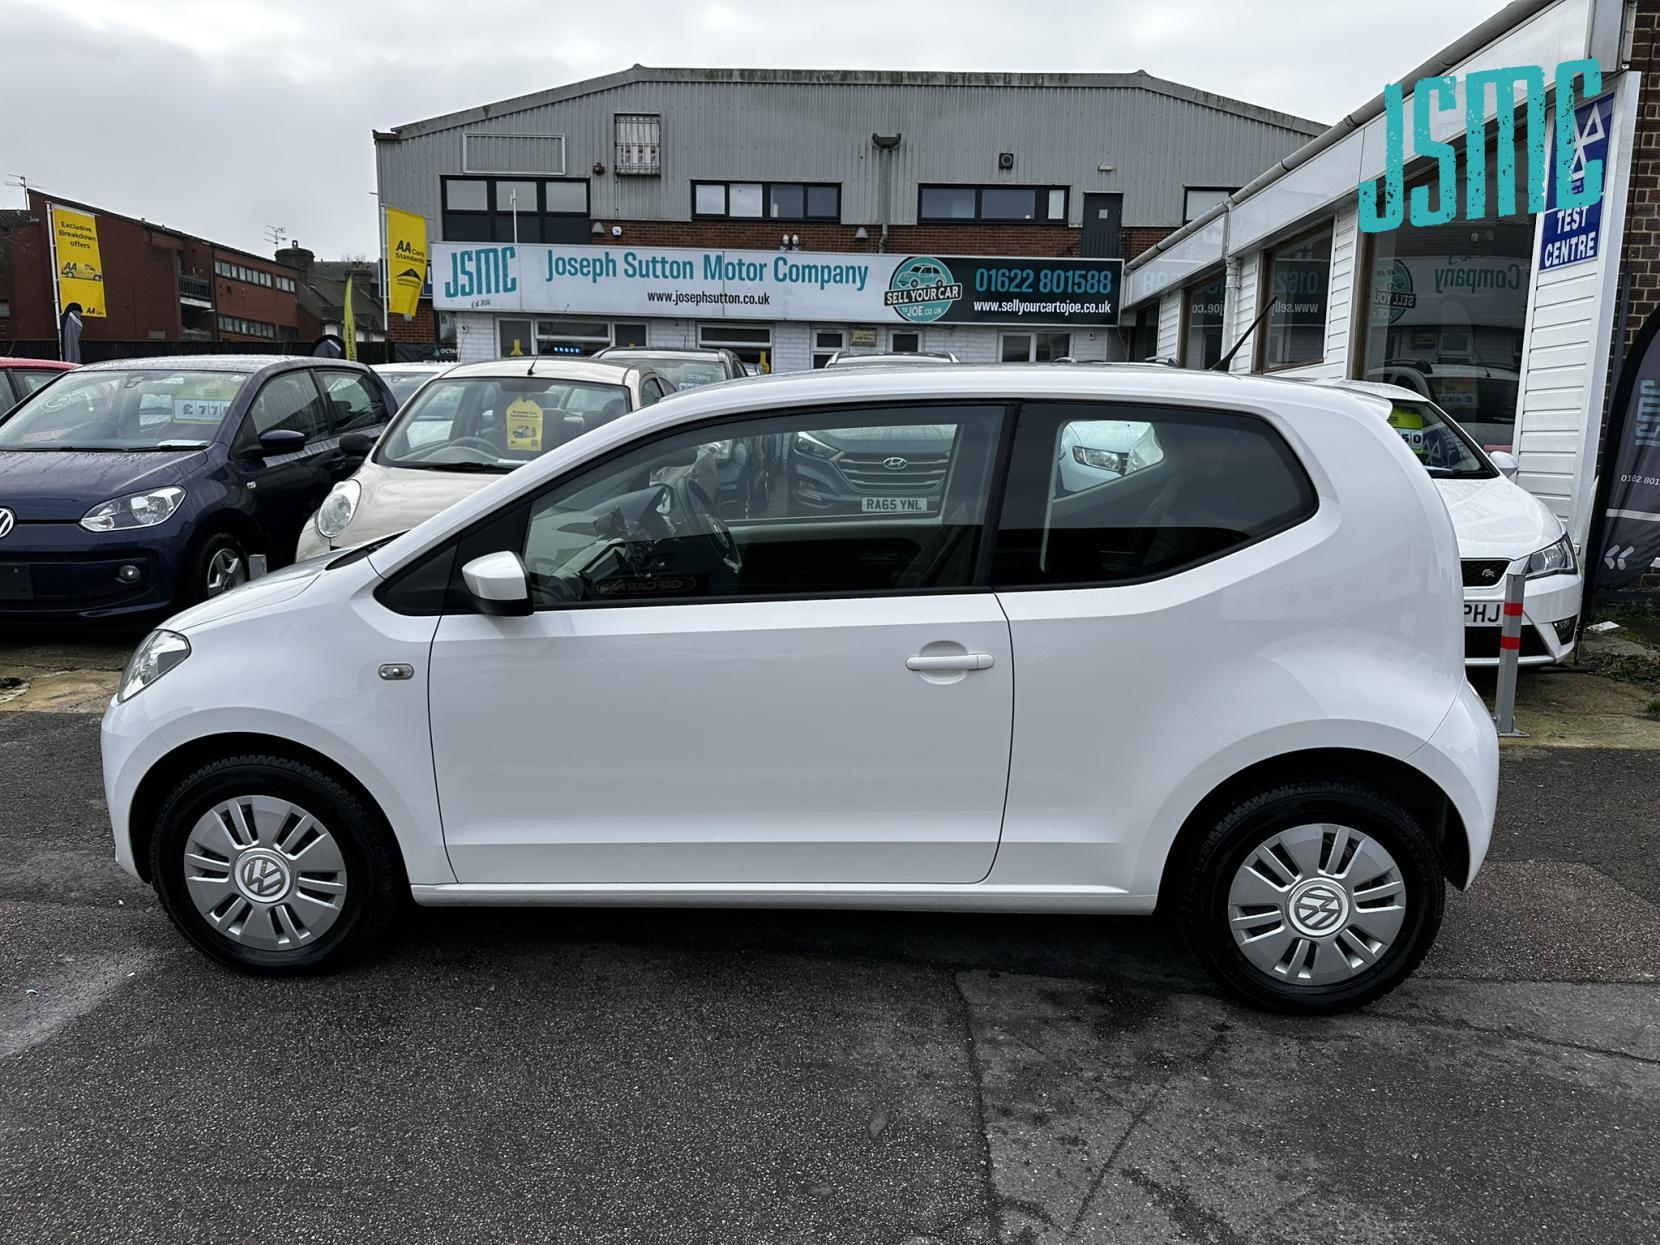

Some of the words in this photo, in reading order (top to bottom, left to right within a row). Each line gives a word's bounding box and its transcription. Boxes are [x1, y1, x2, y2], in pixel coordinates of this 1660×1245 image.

[61, 221, 91, 233] Exclusive
[1557, 206, 1590, 234] TEST
[59, 229, 97, 242] Breakdown
[70, 240, 91, 249] offers
[395, 240, 412, 254] AA
[1544, 231, 1596, 267] CENTRE
[395, 252, 425, 265] Standards
[445, 246, 517, 298] JSMC
[545, 249, 617, 284] Joseph
[623, 252, 694, 279] Sutton
[703, 254, 767, 281] Motor
[773, 256, 869, 291] Company
[975, 268, 1034, 293] 01622
[1039, 270, 1112, 294] 801588
[647, 290, 770, 306] www.josephsutton.co.uk
[886, 291, 909, 304] SELL
[910, 288, 937, 302] YOUR
[938, 286, 959, 299] CAR
[973, 299, 1111, 315] www.sellyourcartojoe.co.uk
[866, 498, 897, 510] RA65
[900, 498, 922, 510] YNL
[1464, 604, 1501, 623] PHJ
